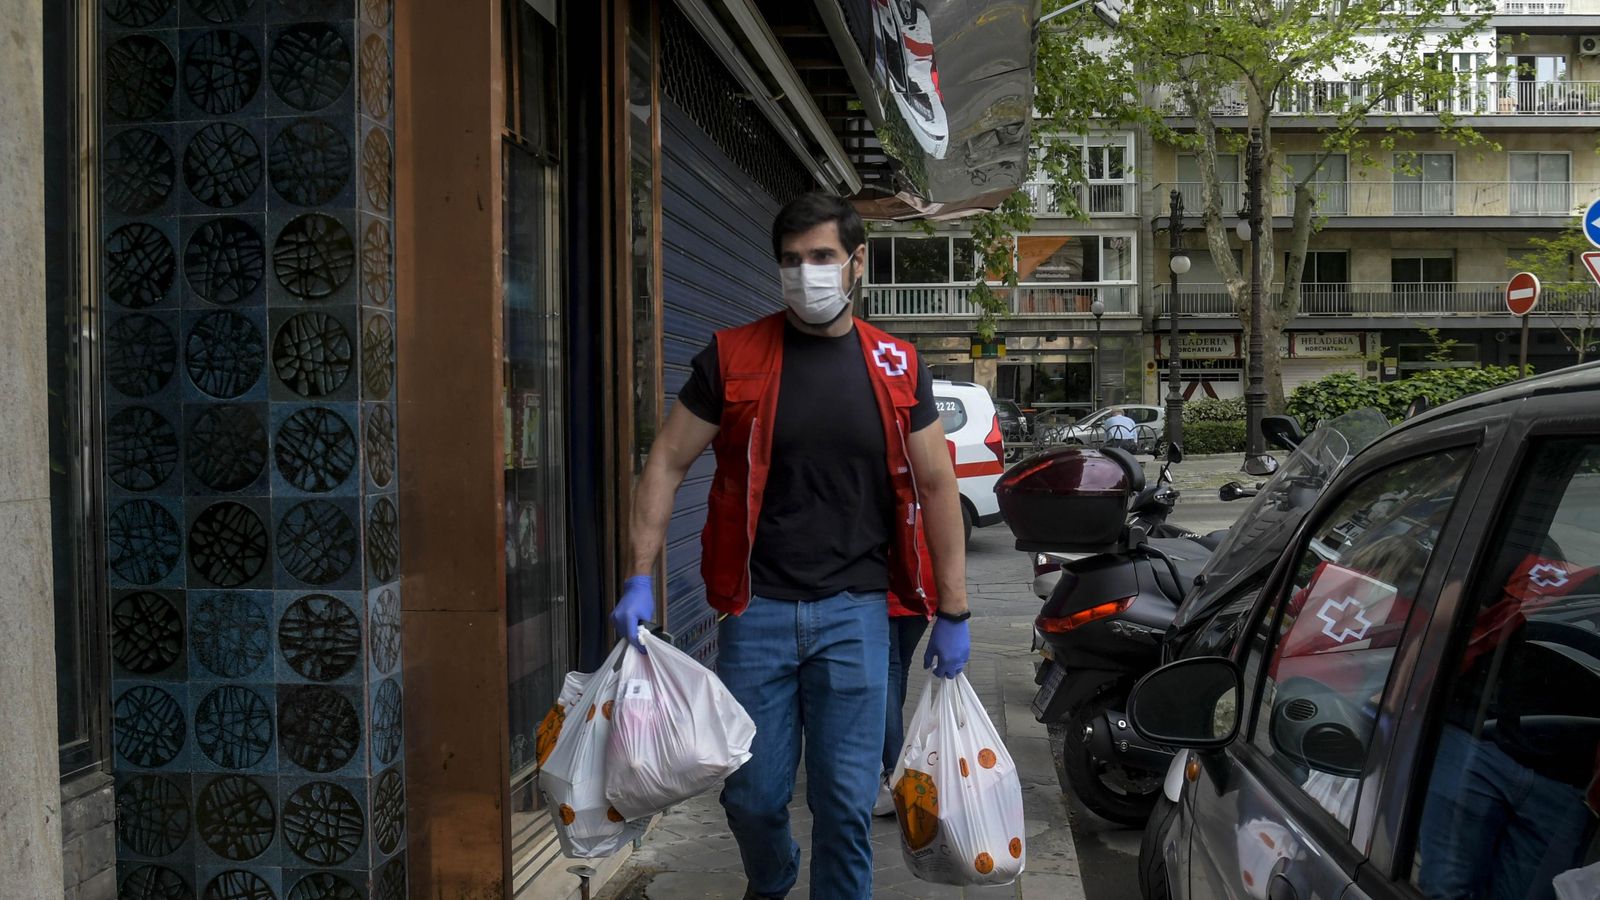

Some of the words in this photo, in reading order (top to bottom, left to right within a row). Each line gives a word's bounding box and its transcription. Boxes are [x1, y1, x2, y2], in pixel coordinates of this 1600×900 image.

[1301, 336, 1354, 345] HELADERIA
[935, 402, 945, 412] 22
[945, 401, 956, 411] 22
